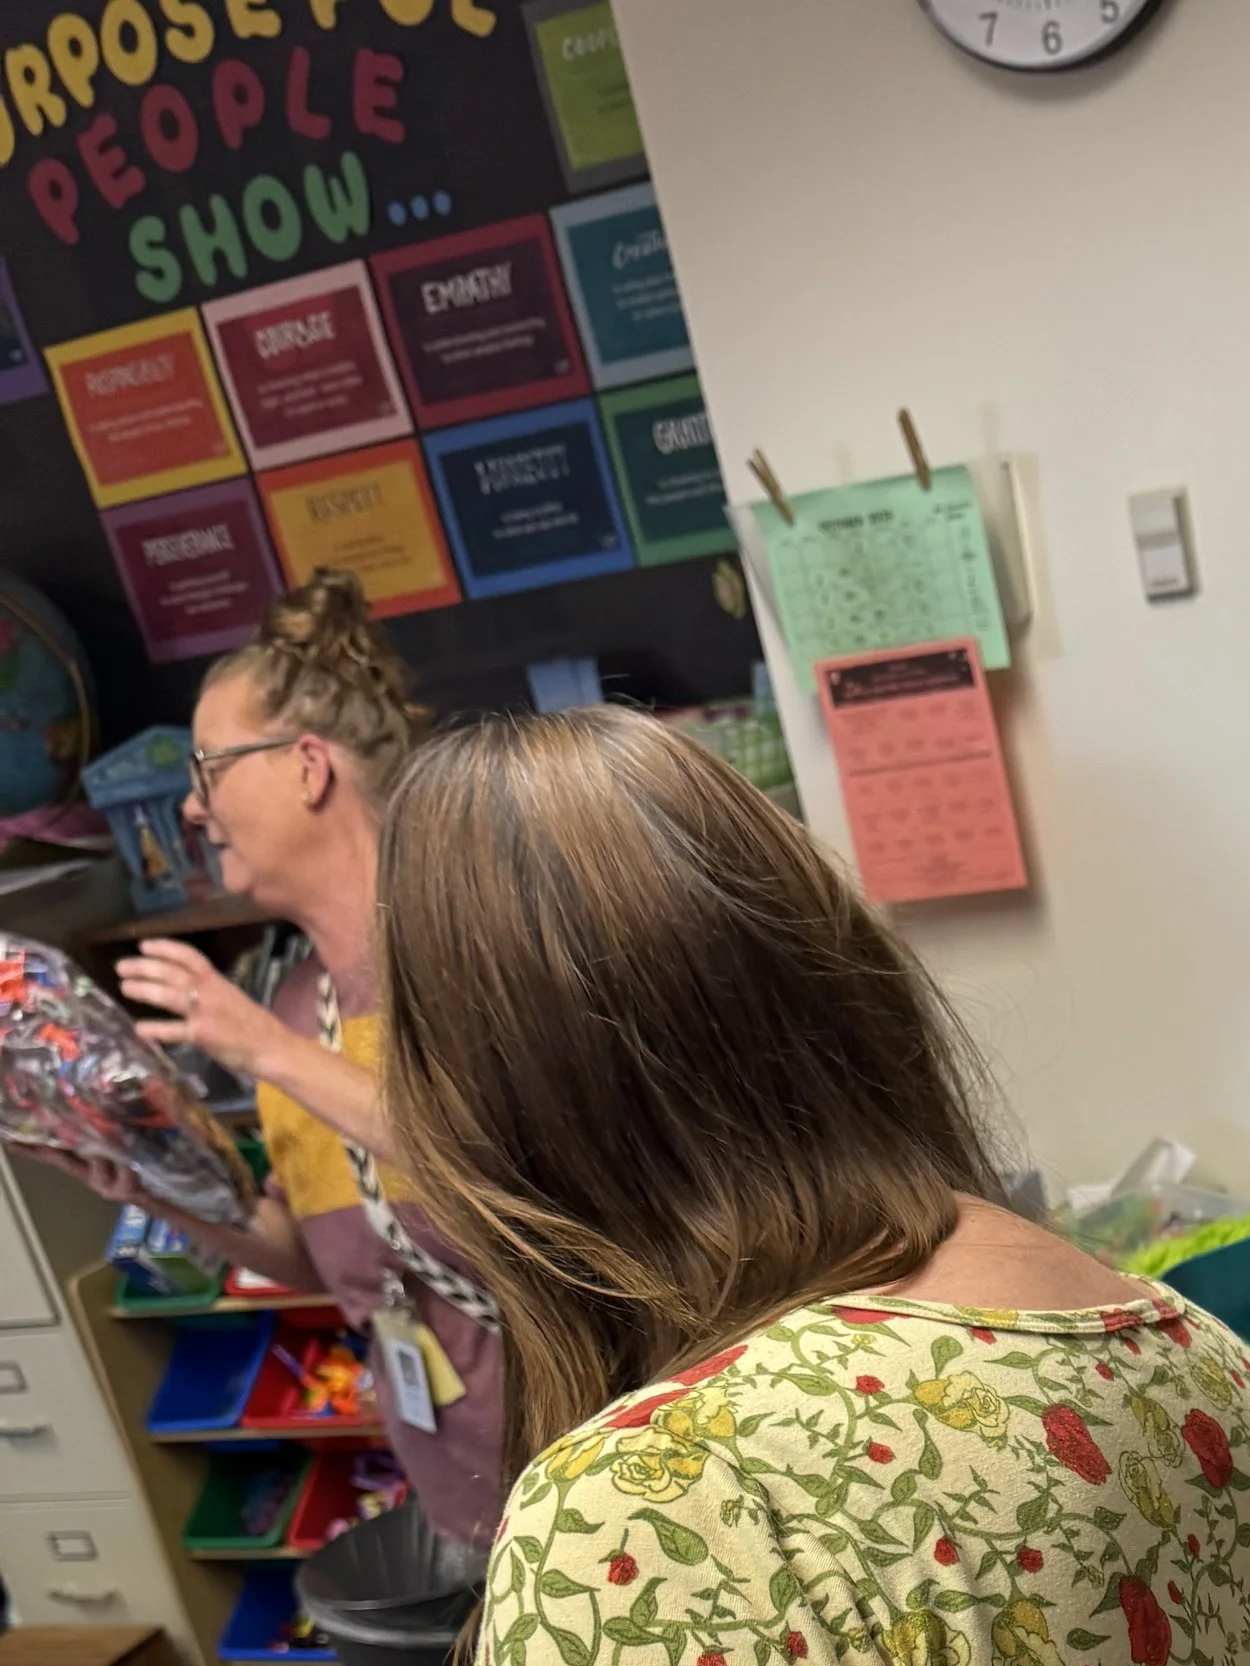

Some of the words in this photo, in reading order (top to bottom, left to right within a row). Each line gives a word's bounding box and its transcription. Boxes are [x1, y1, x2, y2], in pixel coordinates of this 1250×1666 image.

[978, 11, 999, 47] 7
[1040, 20, 1063, 55] 6
[28, 46, 406, 246] PEOPLE
